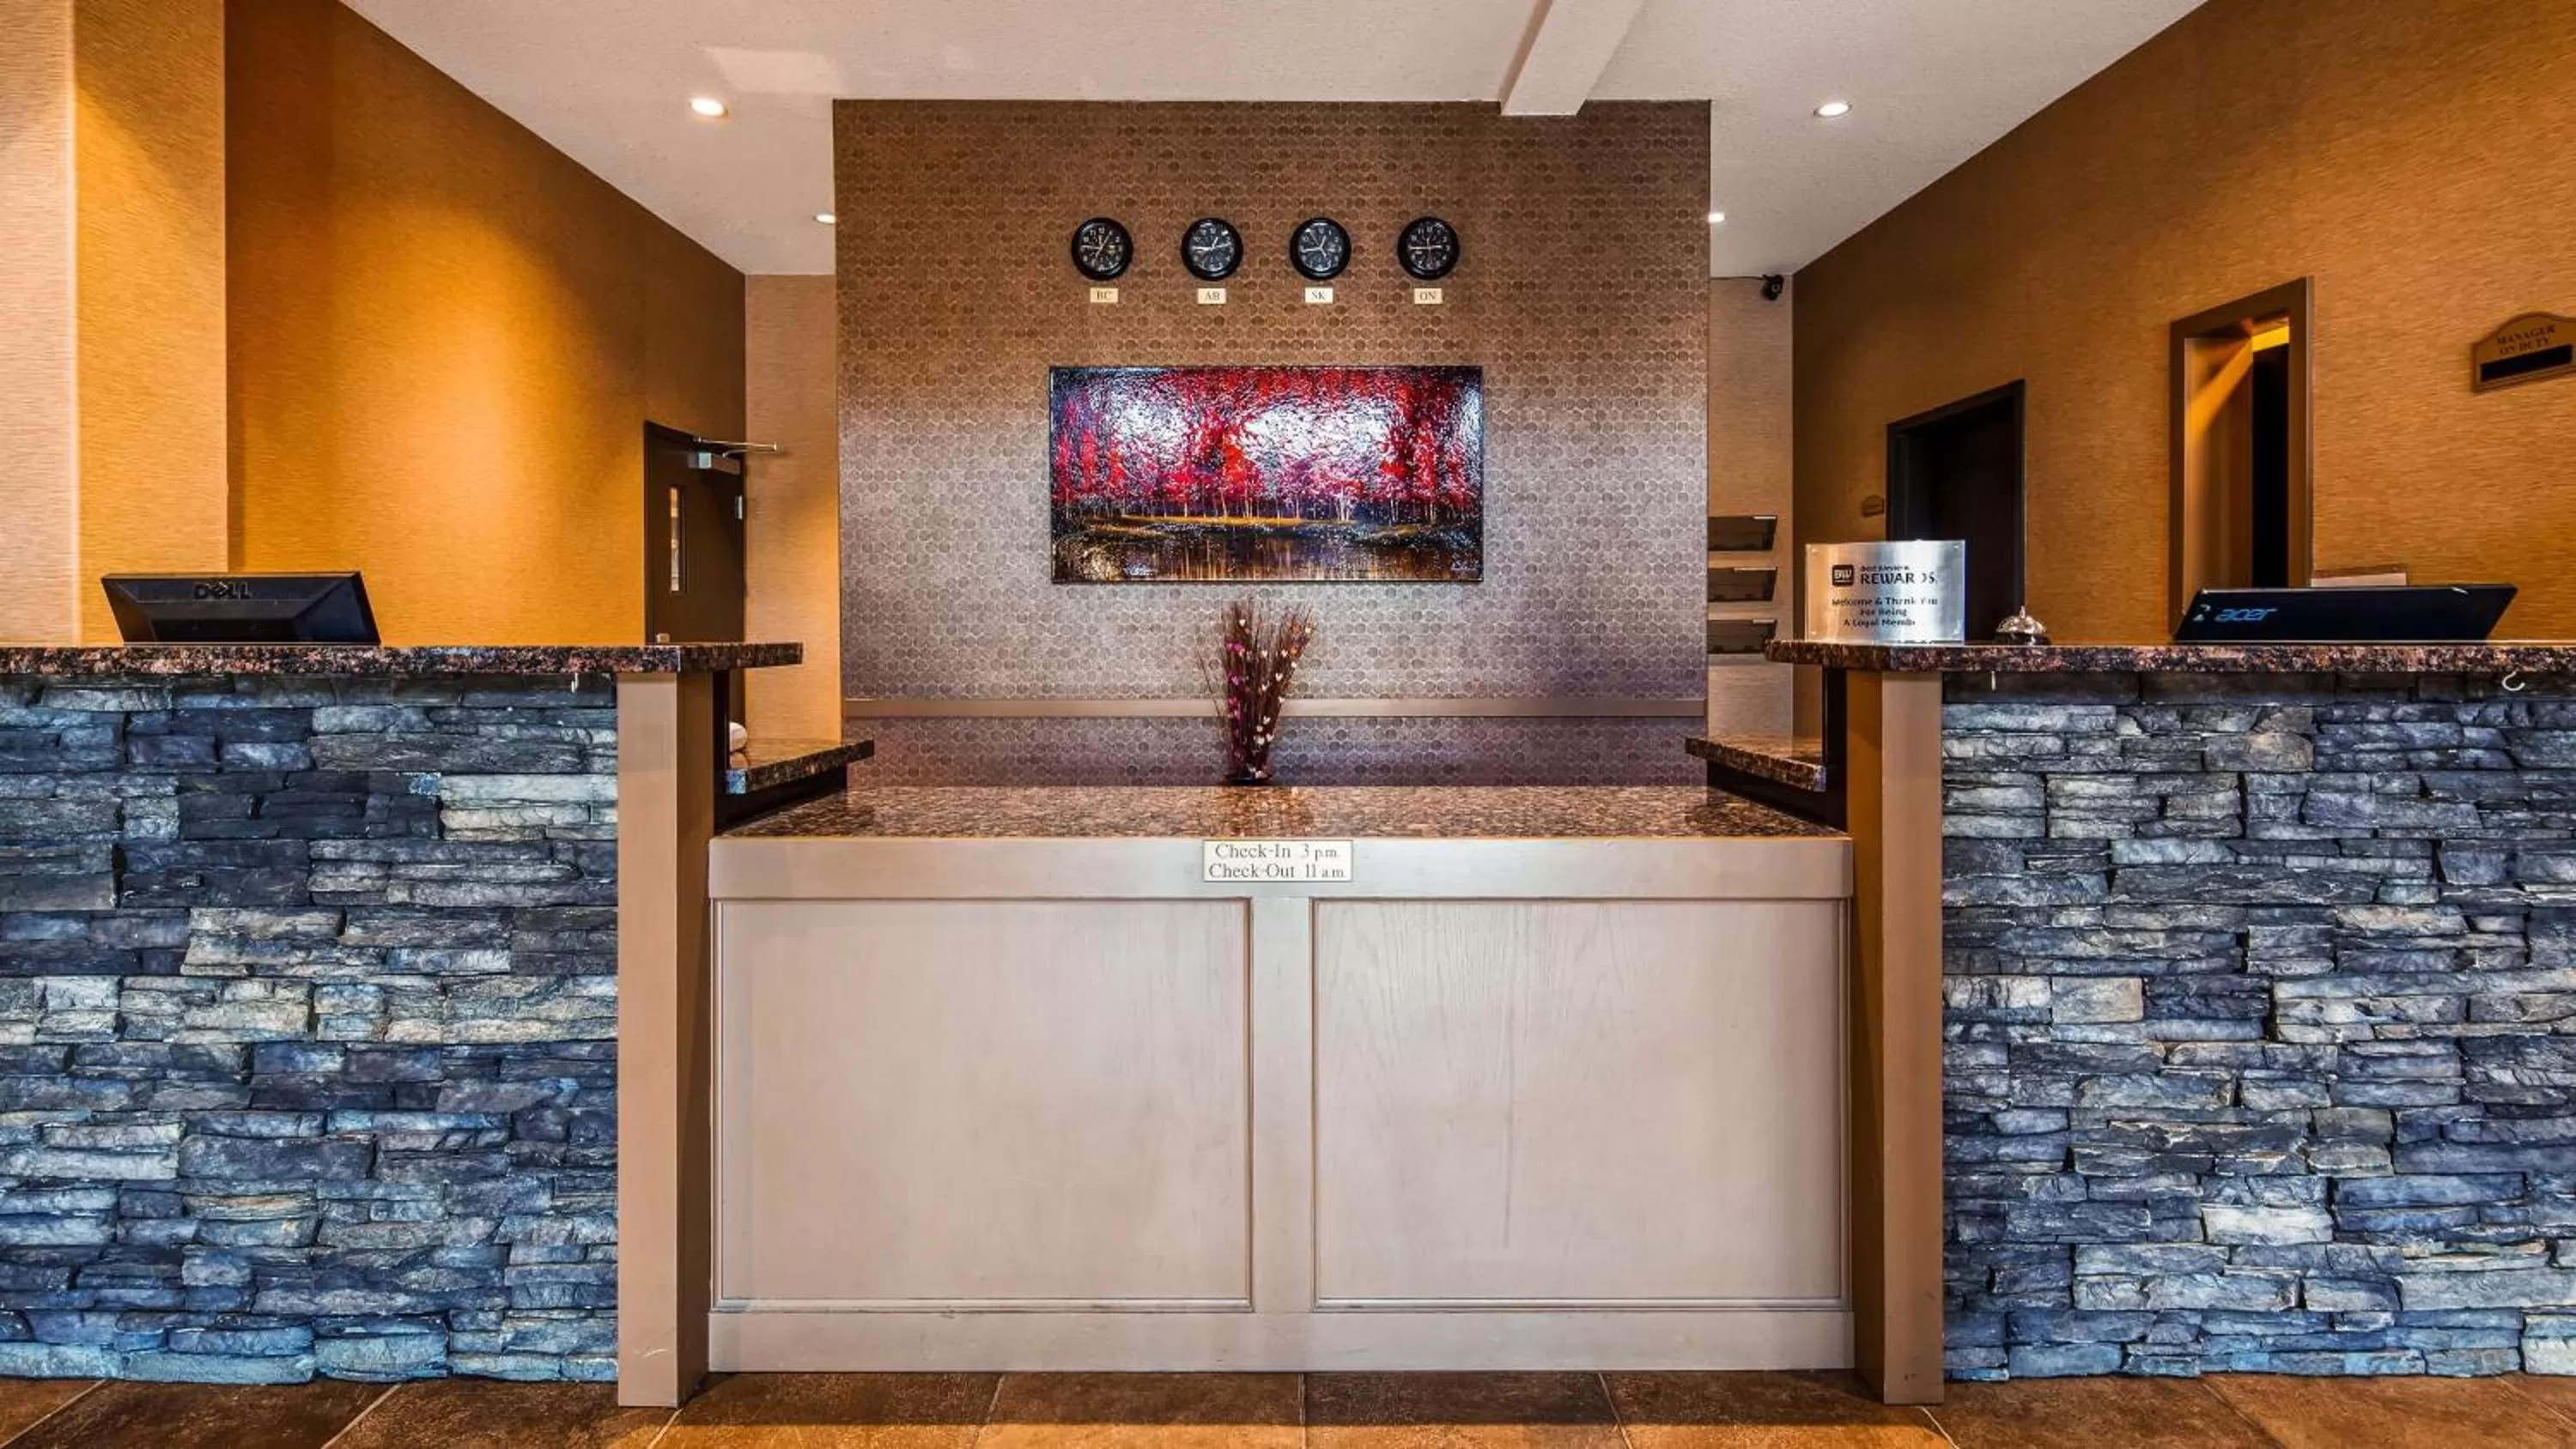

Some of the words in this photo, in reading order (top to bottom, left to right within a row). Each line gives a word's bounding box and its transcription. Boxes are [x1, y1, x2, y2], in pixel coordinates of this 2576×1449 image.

[1419, 290, 1437, 300] ON
[2496, 325, 2556, 344] MANAGER
[2518, 337, 2549, 352] DUTY
[193, 580, 253, 600] DELL
[2215, 608, 2277, 621] acer
[1215, 843, 1291, 858] Check-In
[1301, 843, 1309, 859] 3
[1208, 862, 1295, 878] Check-Out
[1305, 863, 1316, 878] 11
